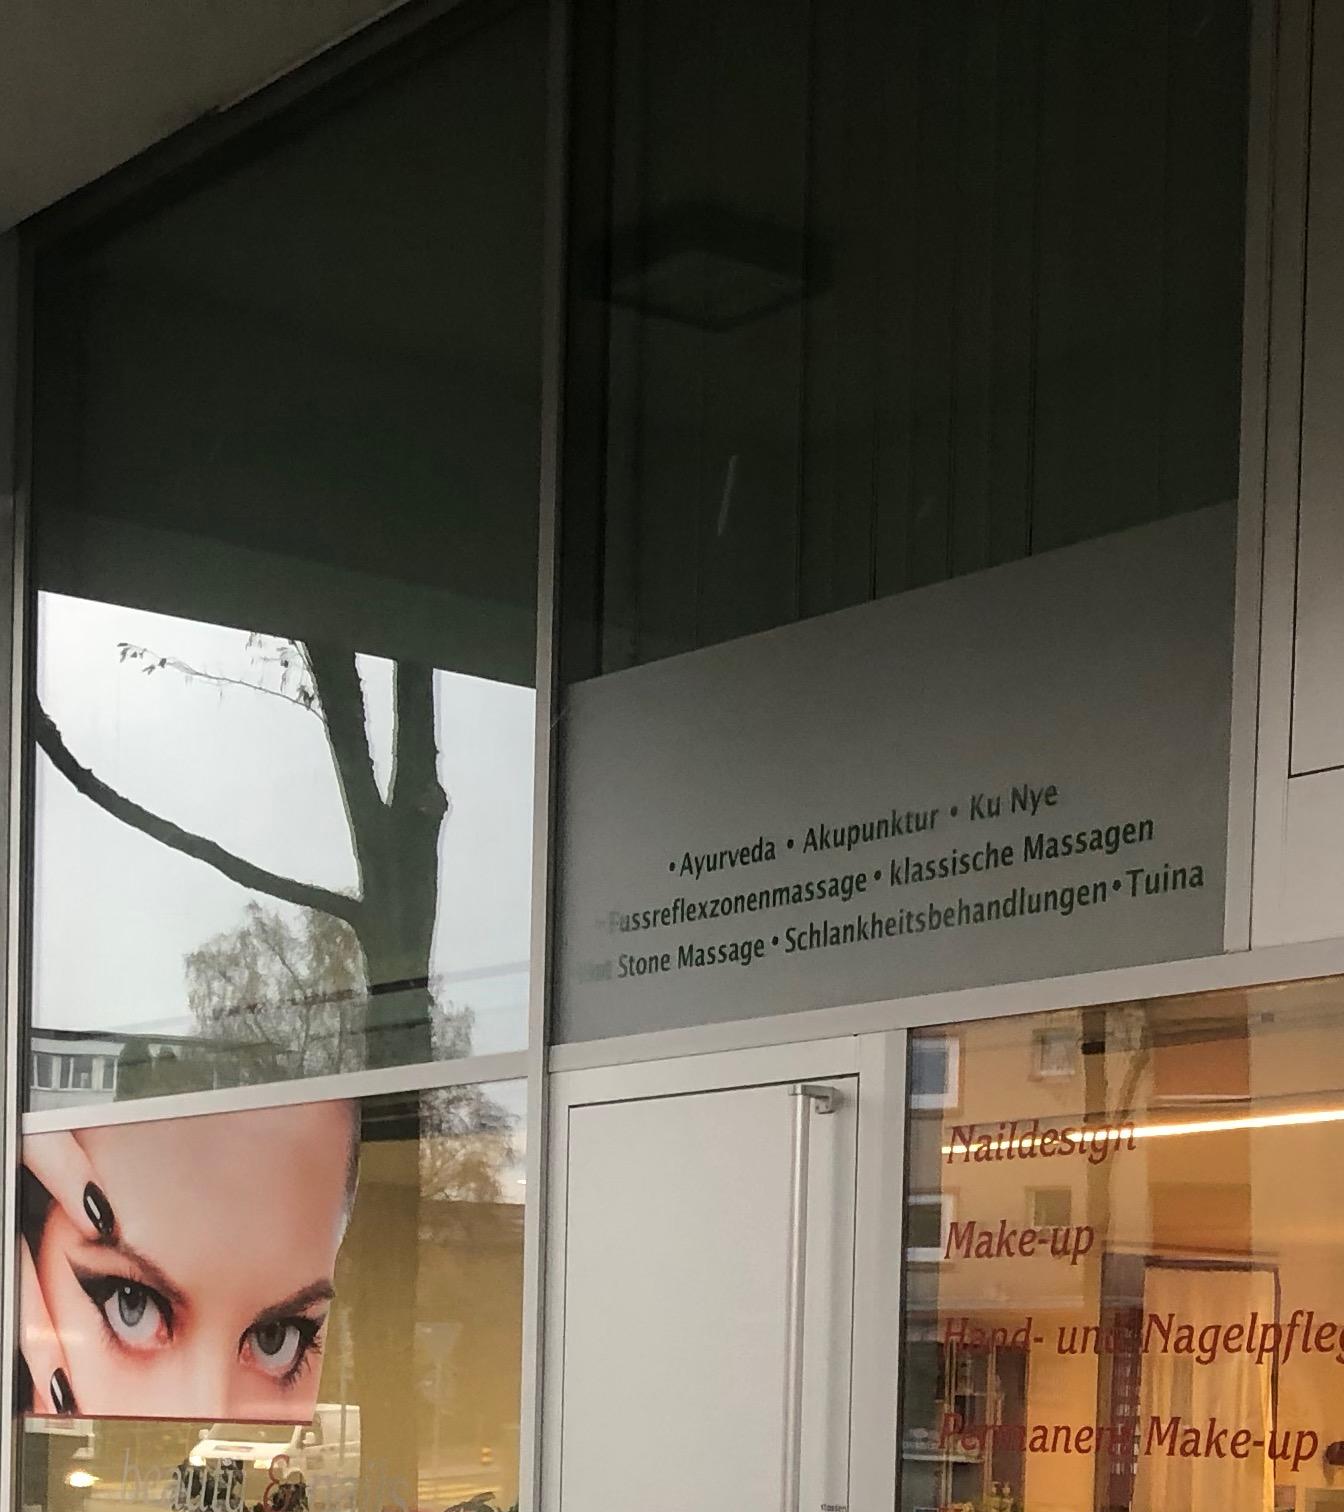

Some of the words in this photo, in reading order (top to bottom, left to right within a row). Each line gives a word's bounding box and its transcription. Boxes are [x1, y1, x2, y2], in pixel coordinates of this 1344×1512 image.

[680, 837, 776, 880] Ayurveda
[803, 809, 940, 853] Akupunktur
[970, 793, 1001, 821] Ku
[1011, 783, 1059, 815] Nye
[609, 871, 868, 933] Fussreflexzonenmassage
[890, 842, 1014, 887] klassische
[1024, 818, 1155, 863] Massagen
[617, 952, 671, 979] Stone
[677, 935, 765, 971] Massage
[785, 880, 1107, 954] Schlankheitsbehandlungen
[1126, 863, 1205, 897] Tuina
[946, 1119, 1137, 1165] Naildesign
[944, 1219, 1096, 1266] Make-up
[943, 1316, 1044, 1355] Hand-
[1057, 1315, 1128, 1356] und
[1143, 1415, 1320, 1473] Make-up
